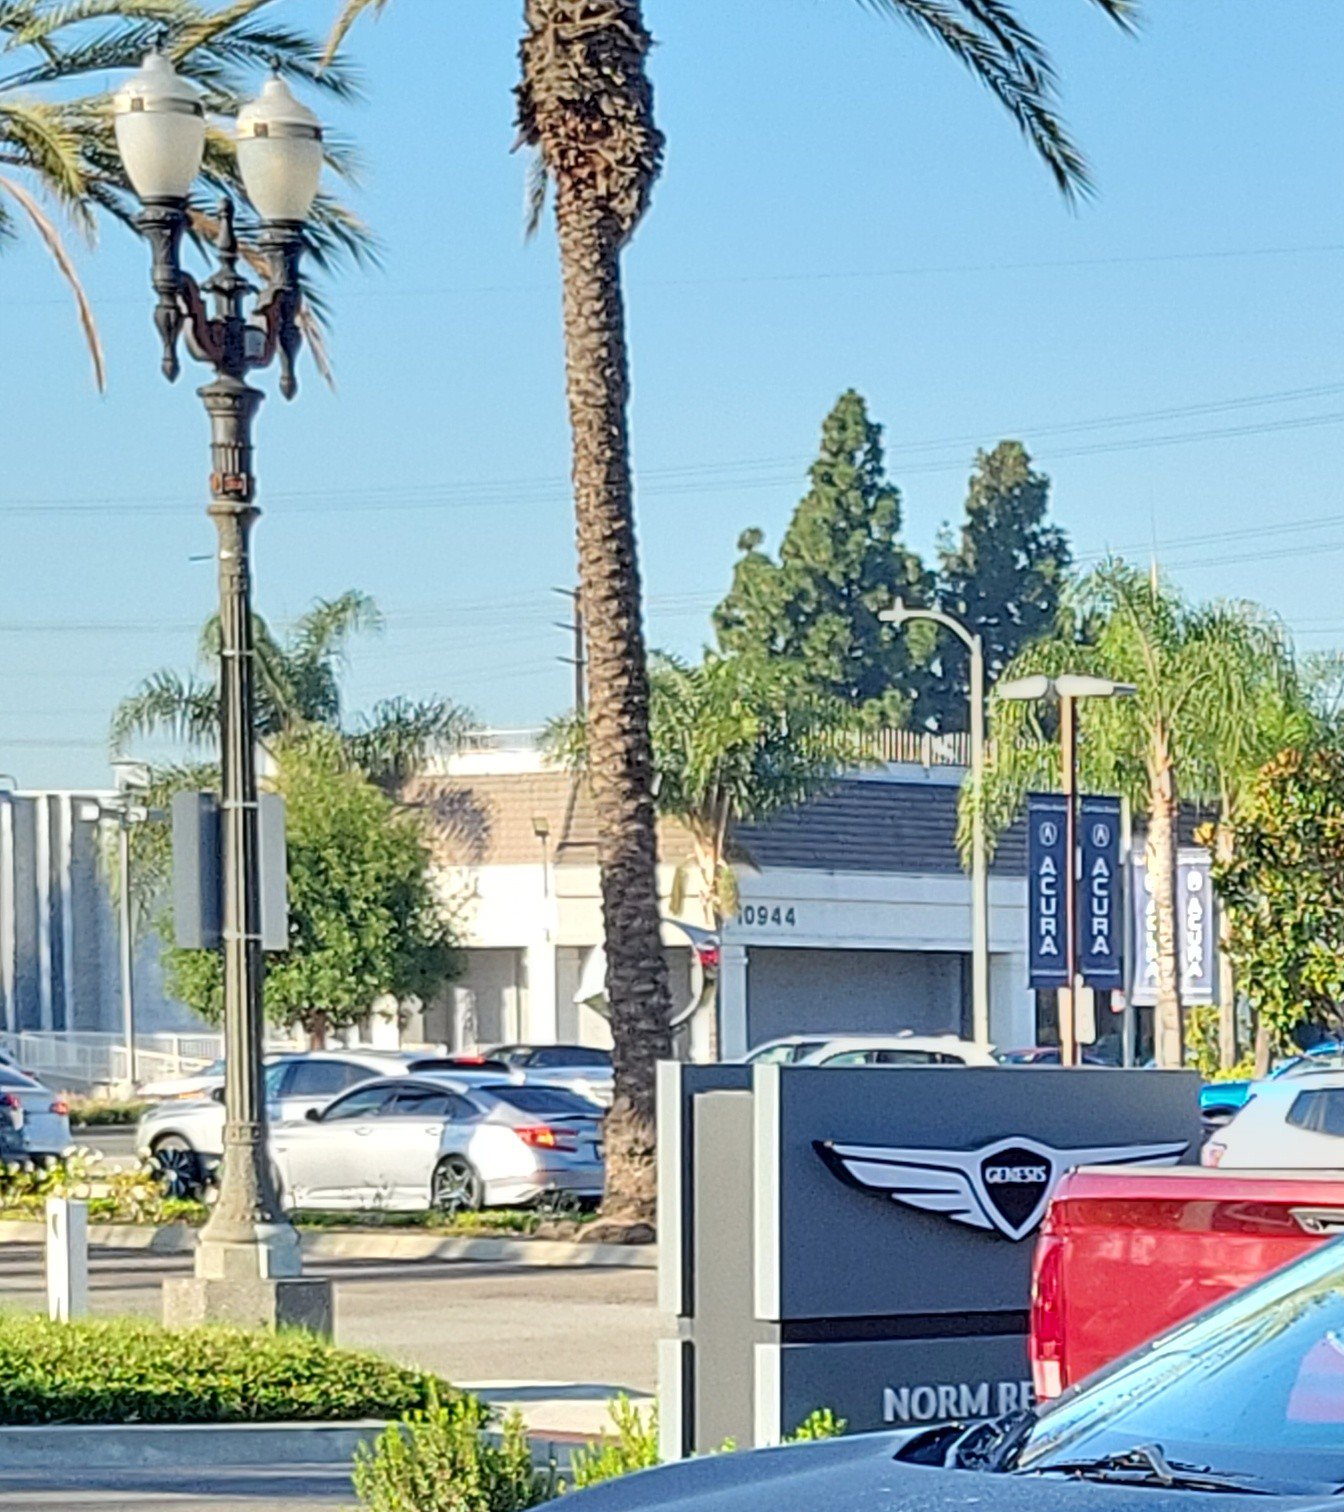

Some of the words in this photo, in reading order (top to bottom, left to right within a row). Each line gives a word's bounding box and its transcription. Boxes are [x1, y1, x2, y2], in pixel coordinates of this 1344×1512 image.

[1039, 856, 1058, 955] ACURA
[1091, 857, 1110, 955] ACURA
[1186, 897, 1204, 978] ACURA
[985, 1166, 1047, 1184] GENESIS
[883, 1383, 989, 1422] NORM
